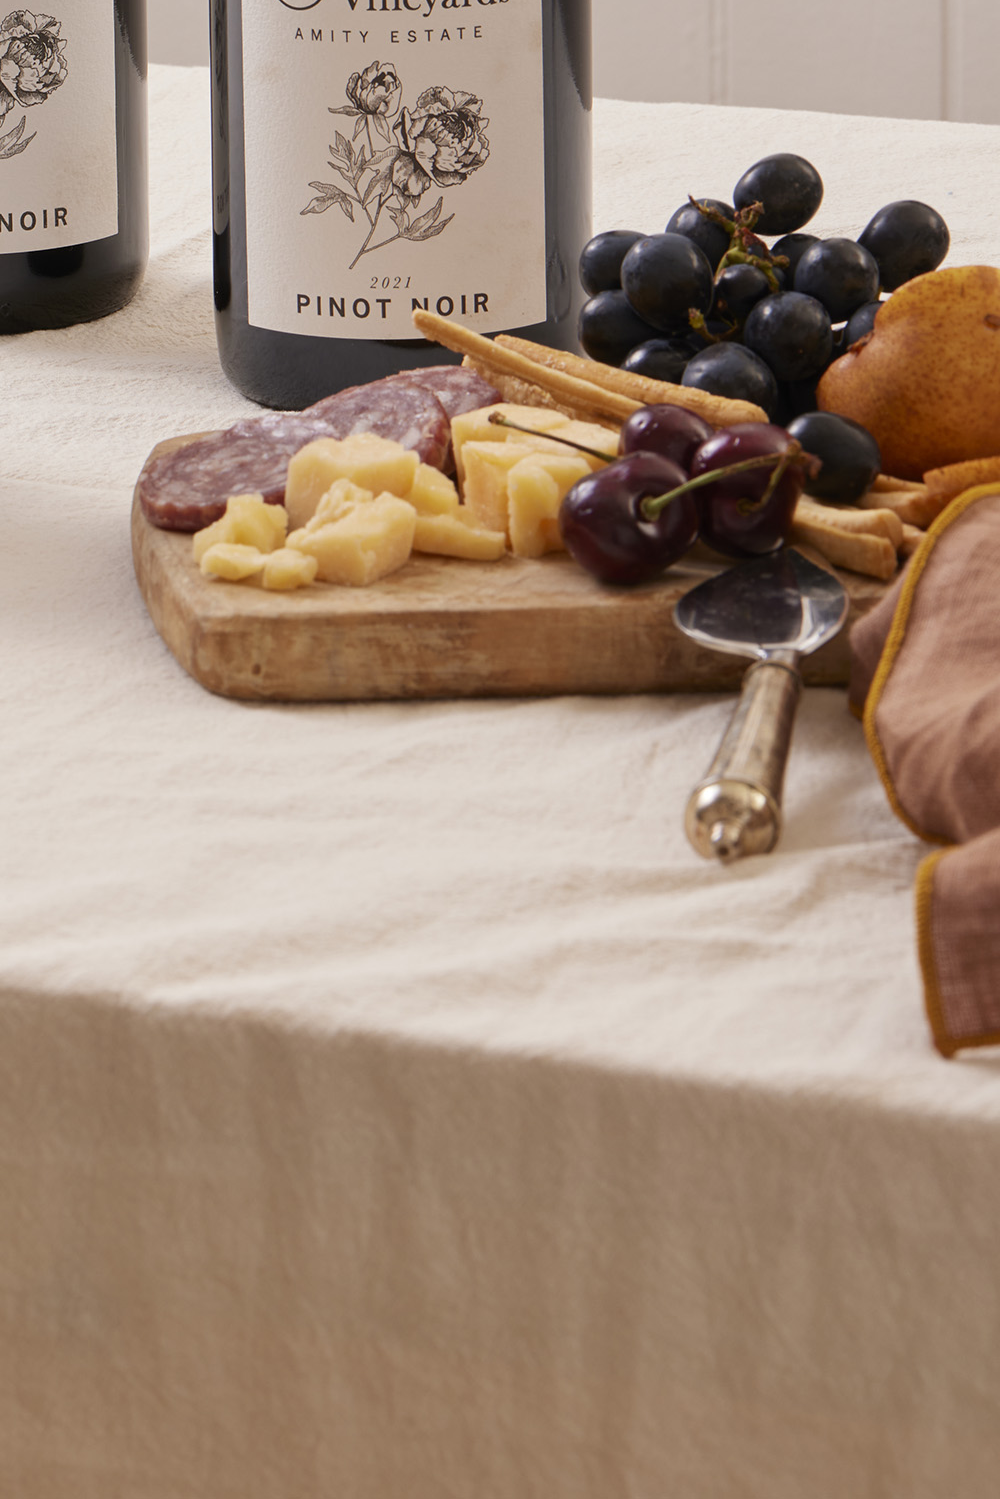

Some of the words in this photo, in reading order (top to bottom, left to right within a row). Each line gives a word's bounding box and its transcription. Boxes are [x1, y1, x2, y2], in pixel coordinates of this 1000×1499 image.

[295, 28, 368, 43] AMITY
[391, 26, 482, 43] ESTATE
[370, 277, 410, 289] 2021
[297, 294, 391, 318] PINOT
